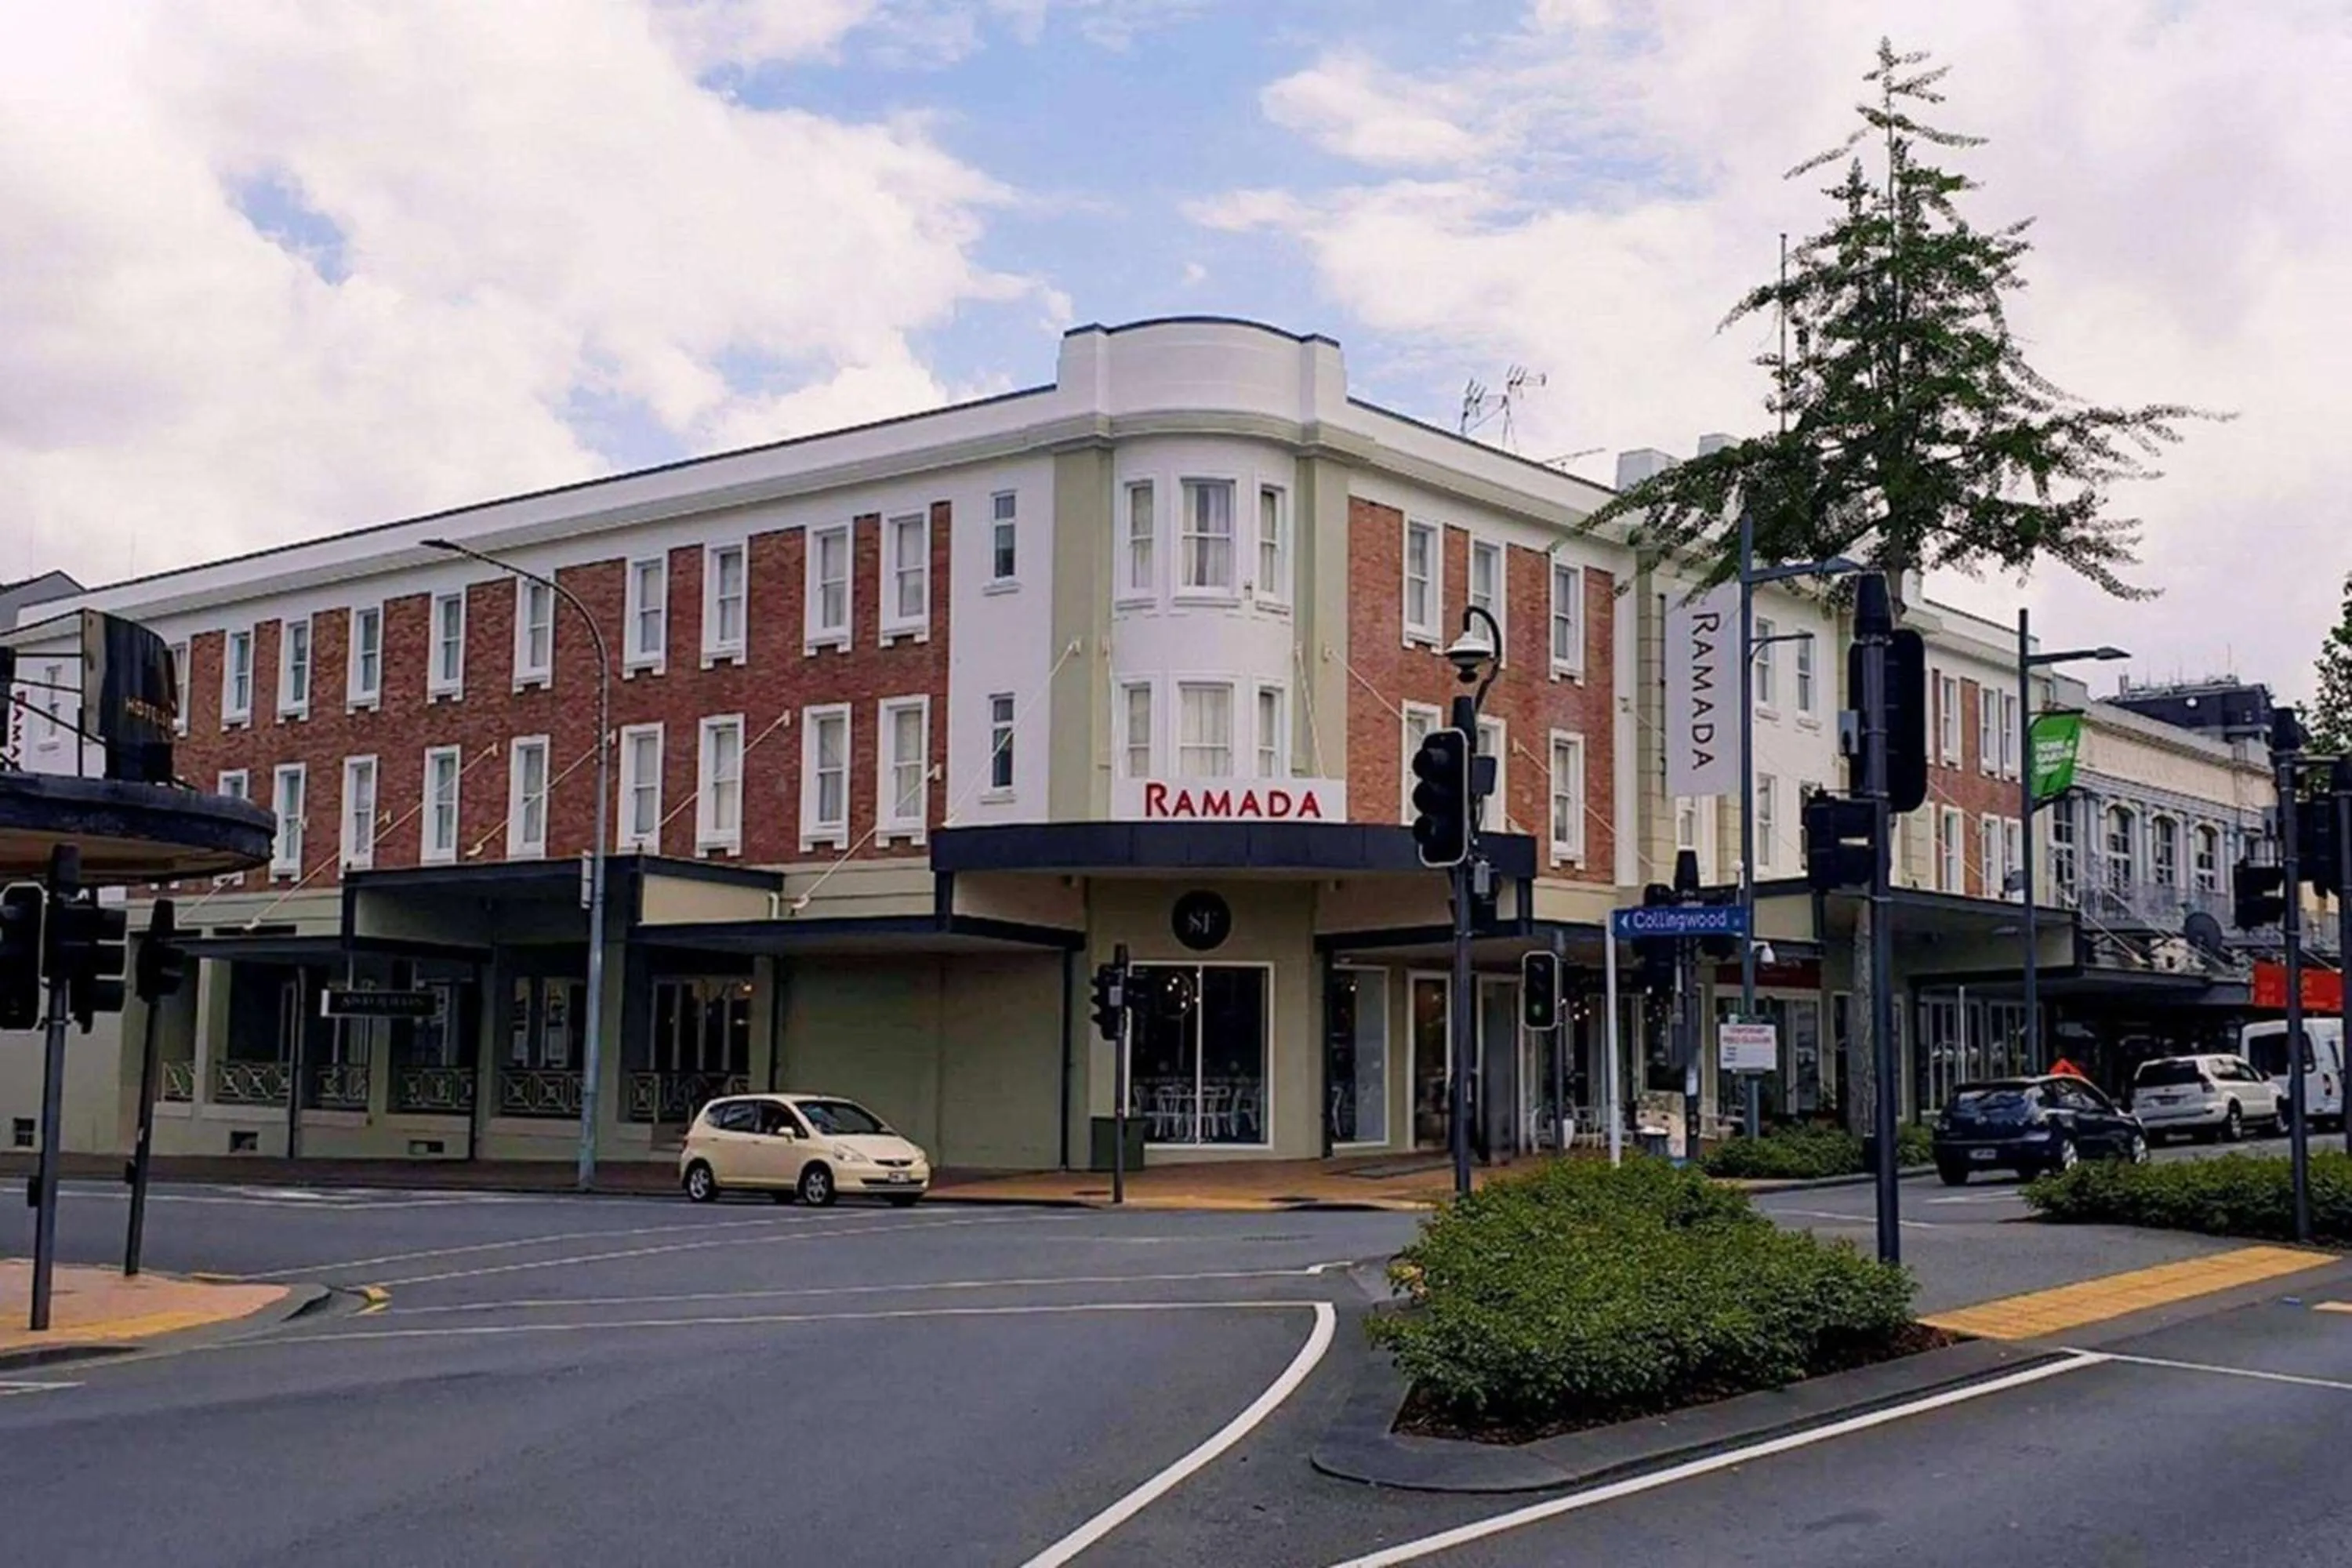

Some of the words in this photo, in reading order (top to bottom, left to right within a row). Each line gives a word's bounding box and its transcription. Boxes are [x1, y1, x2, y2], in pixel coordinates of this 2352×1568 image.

[1692, 612, 1721, 771] RAMADA
[1145, 782, 1322, 818] RAMADA
[1632, 909, 1727, 931] Collingwood
